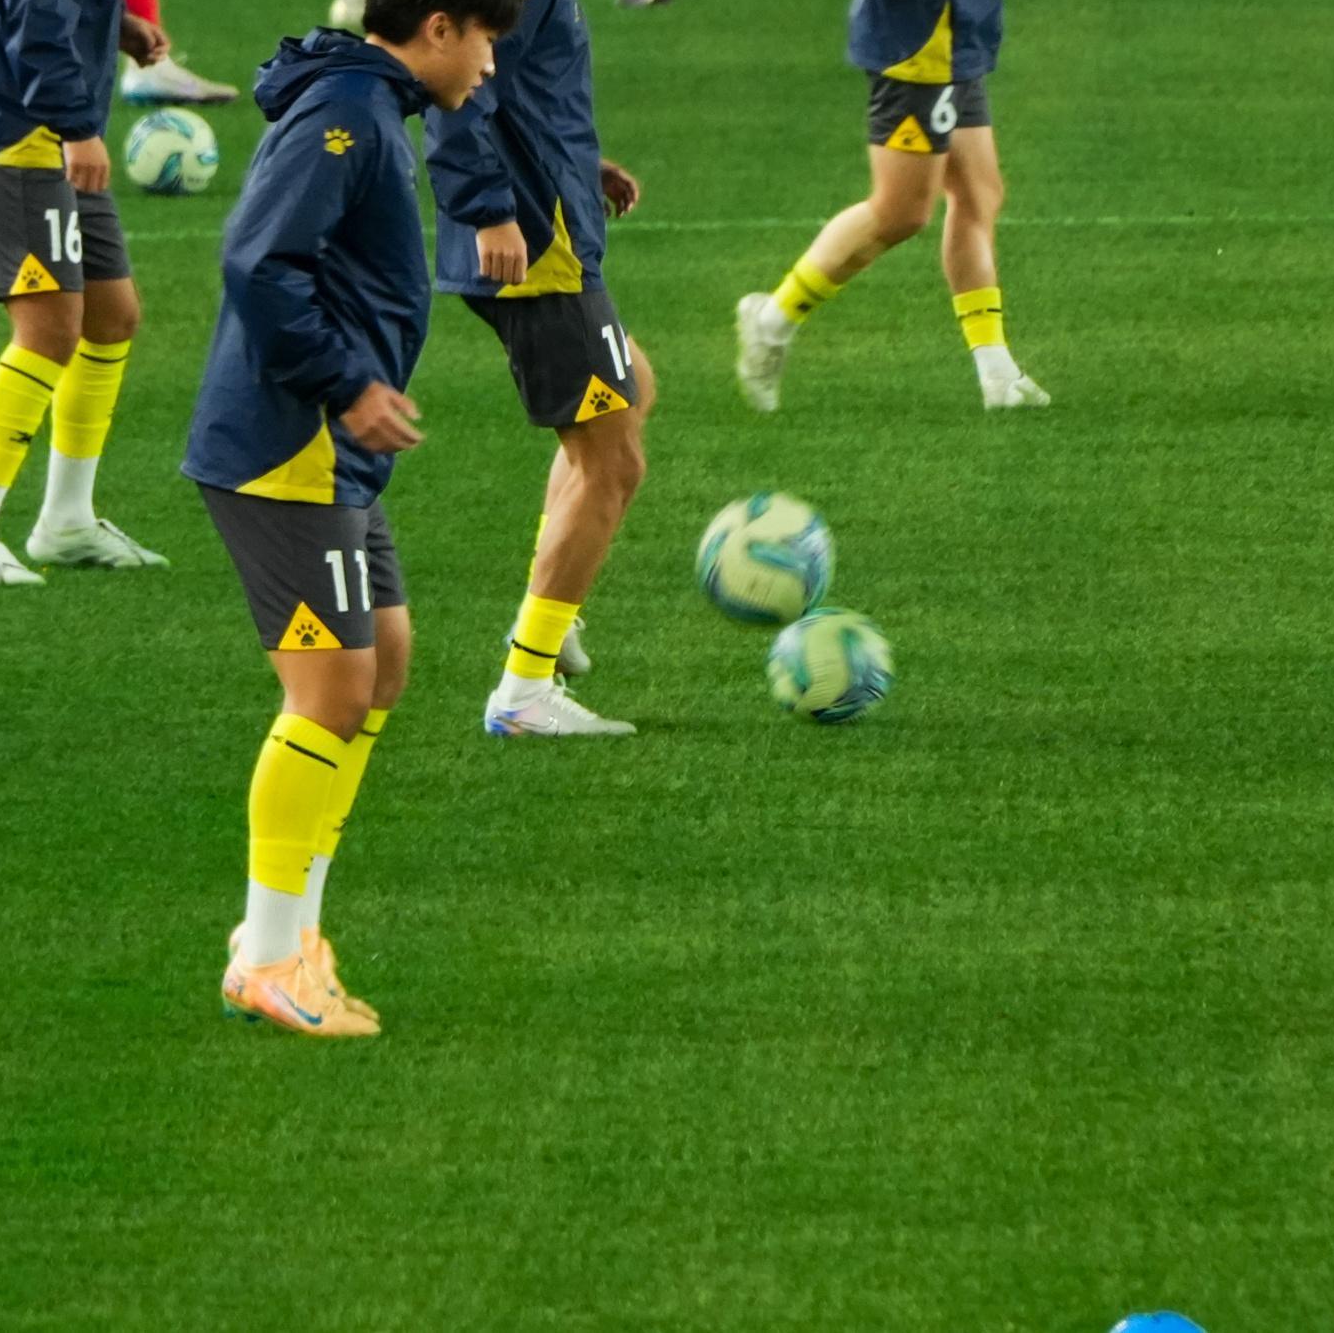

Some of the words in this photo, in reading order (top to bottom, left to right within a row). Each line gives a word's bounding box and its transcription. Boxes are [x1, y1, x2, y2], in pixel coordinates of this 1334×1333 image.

[929, 84, 958, 134] 6
[44, 208, 83, 264] 16
[325, 551, 371, 613] 11
